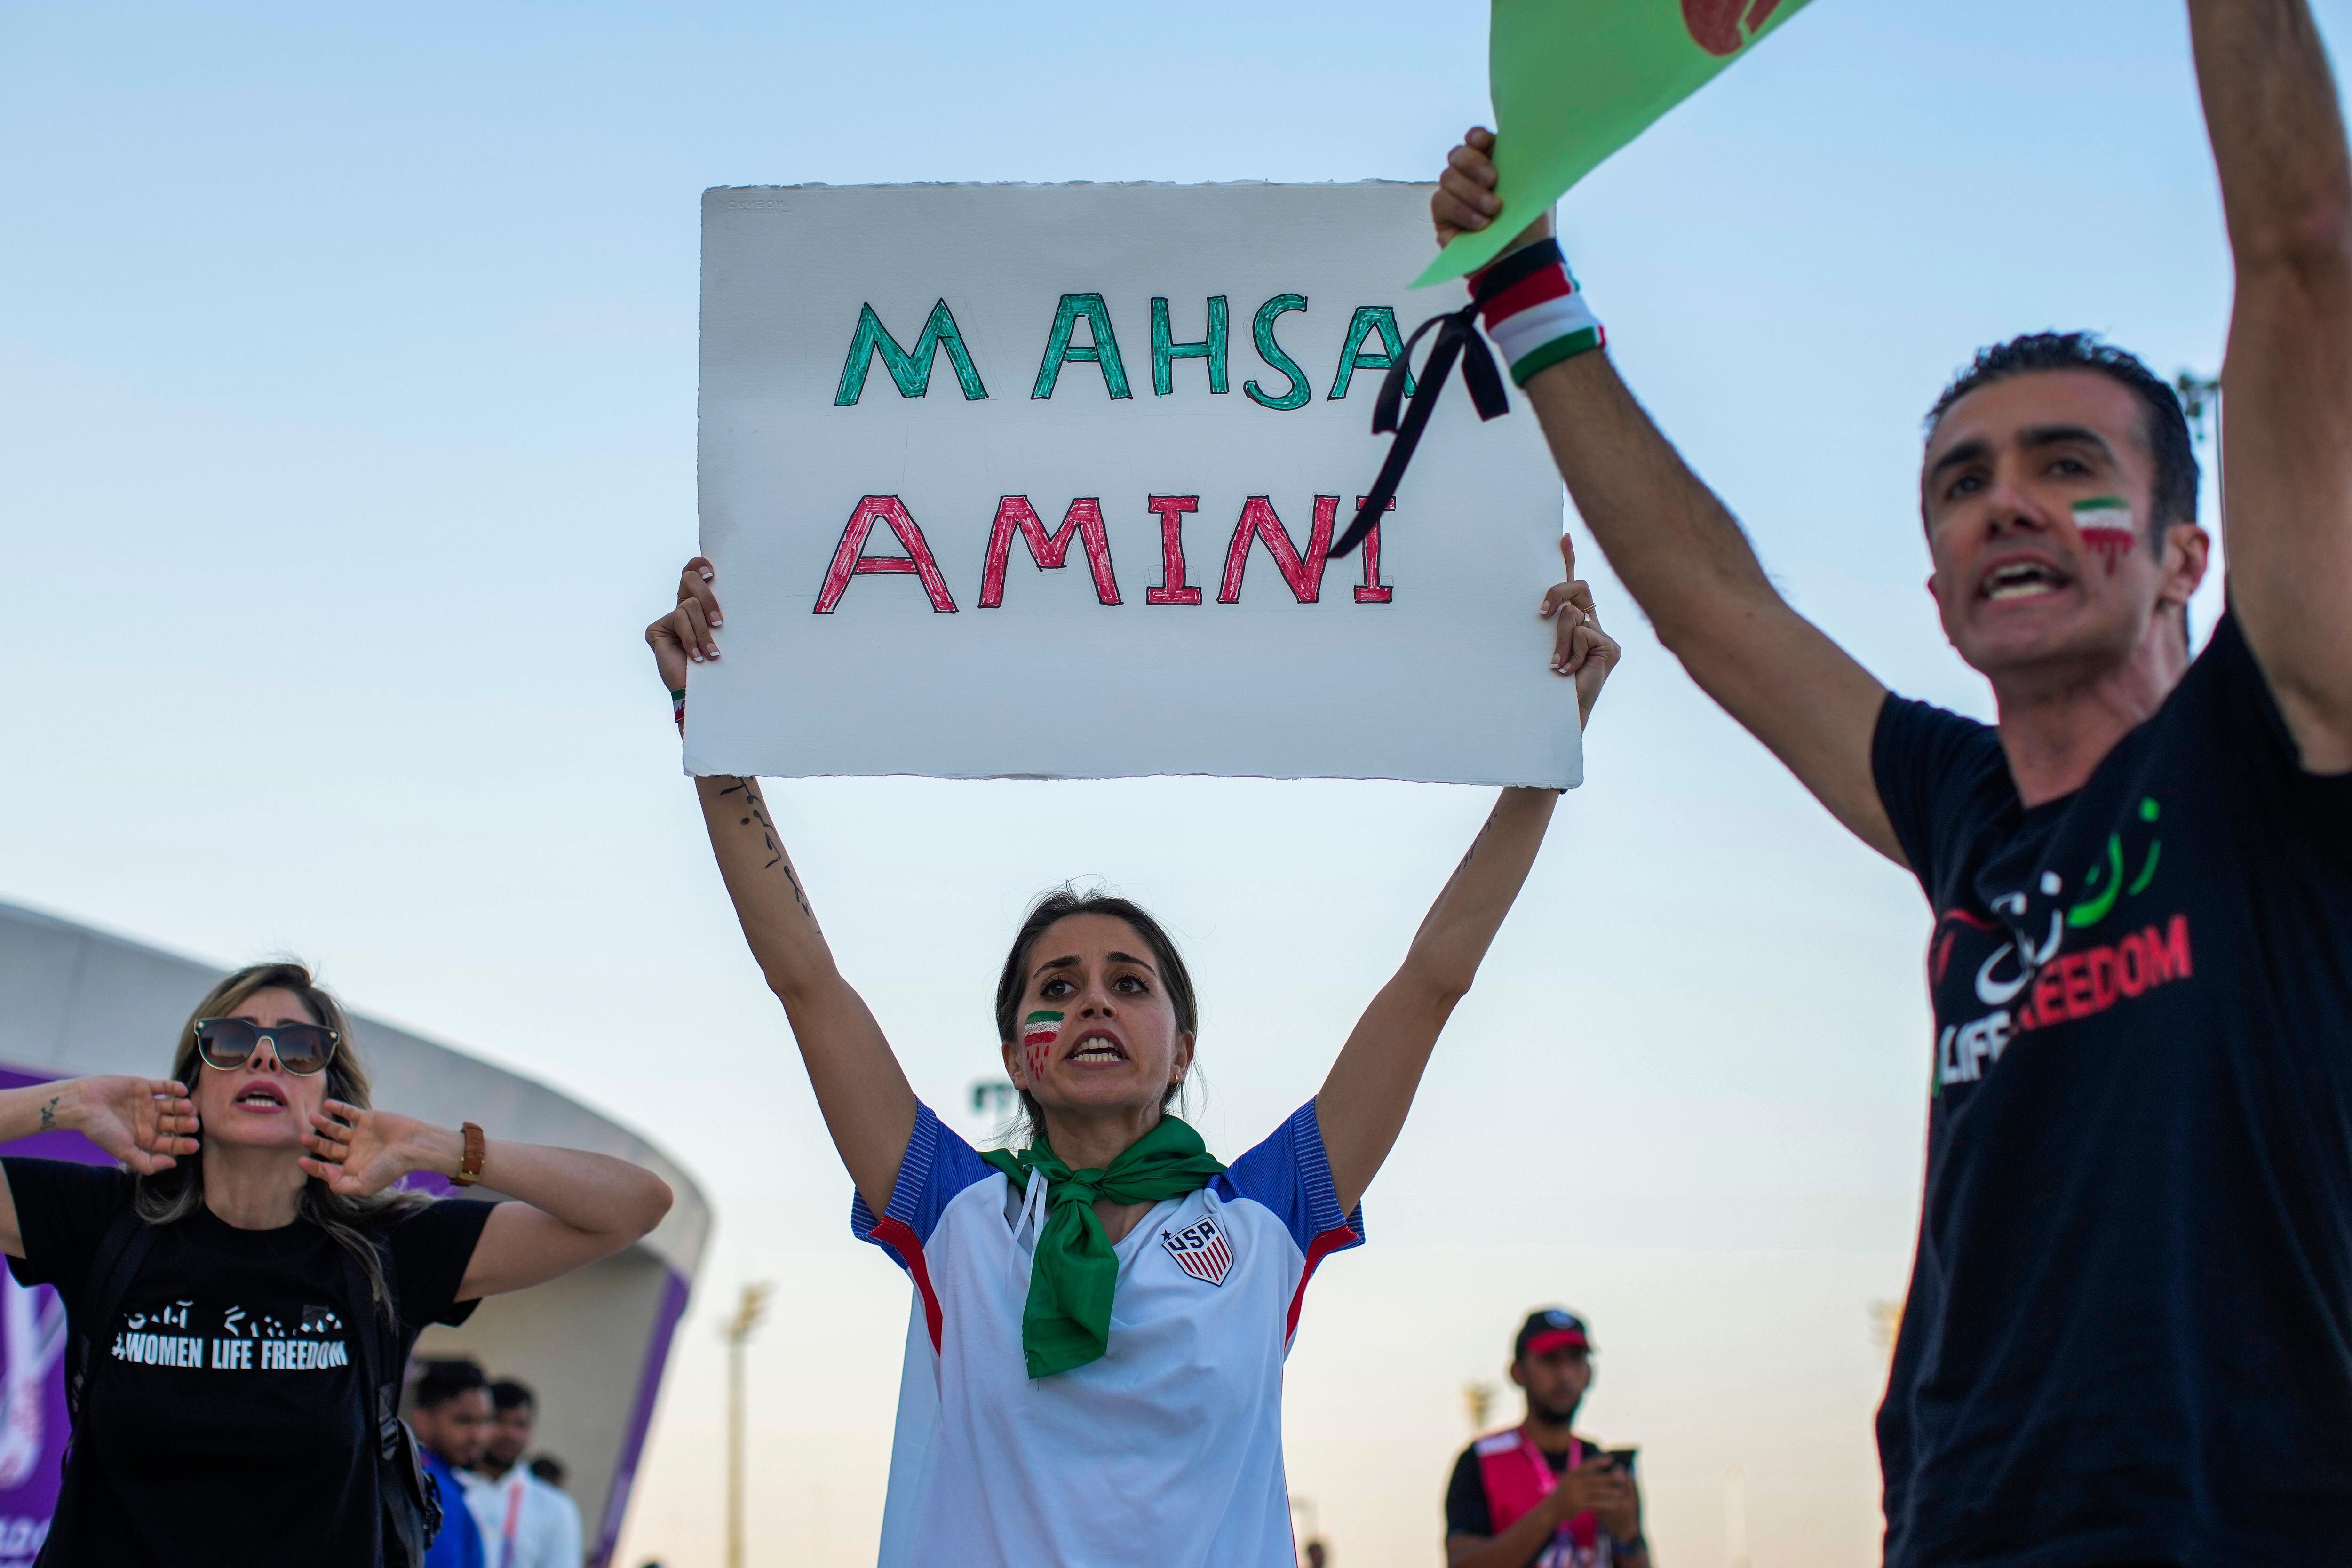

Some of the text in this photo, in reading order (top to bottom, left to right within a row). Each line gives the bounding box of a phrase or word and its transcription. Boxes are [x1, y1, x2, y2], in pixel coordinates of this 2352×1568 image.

[834, 292, 1418, 411] MAHSA
[812, 493, 1396, 614] AMINI
[2011, 914, 2193, 1036] EEDOM
[1167, 1220, 1216, 1251] USA
[211, 1337, 253, 1369] LIFE
[261, 1339, 349, 1370] FREEDOM
